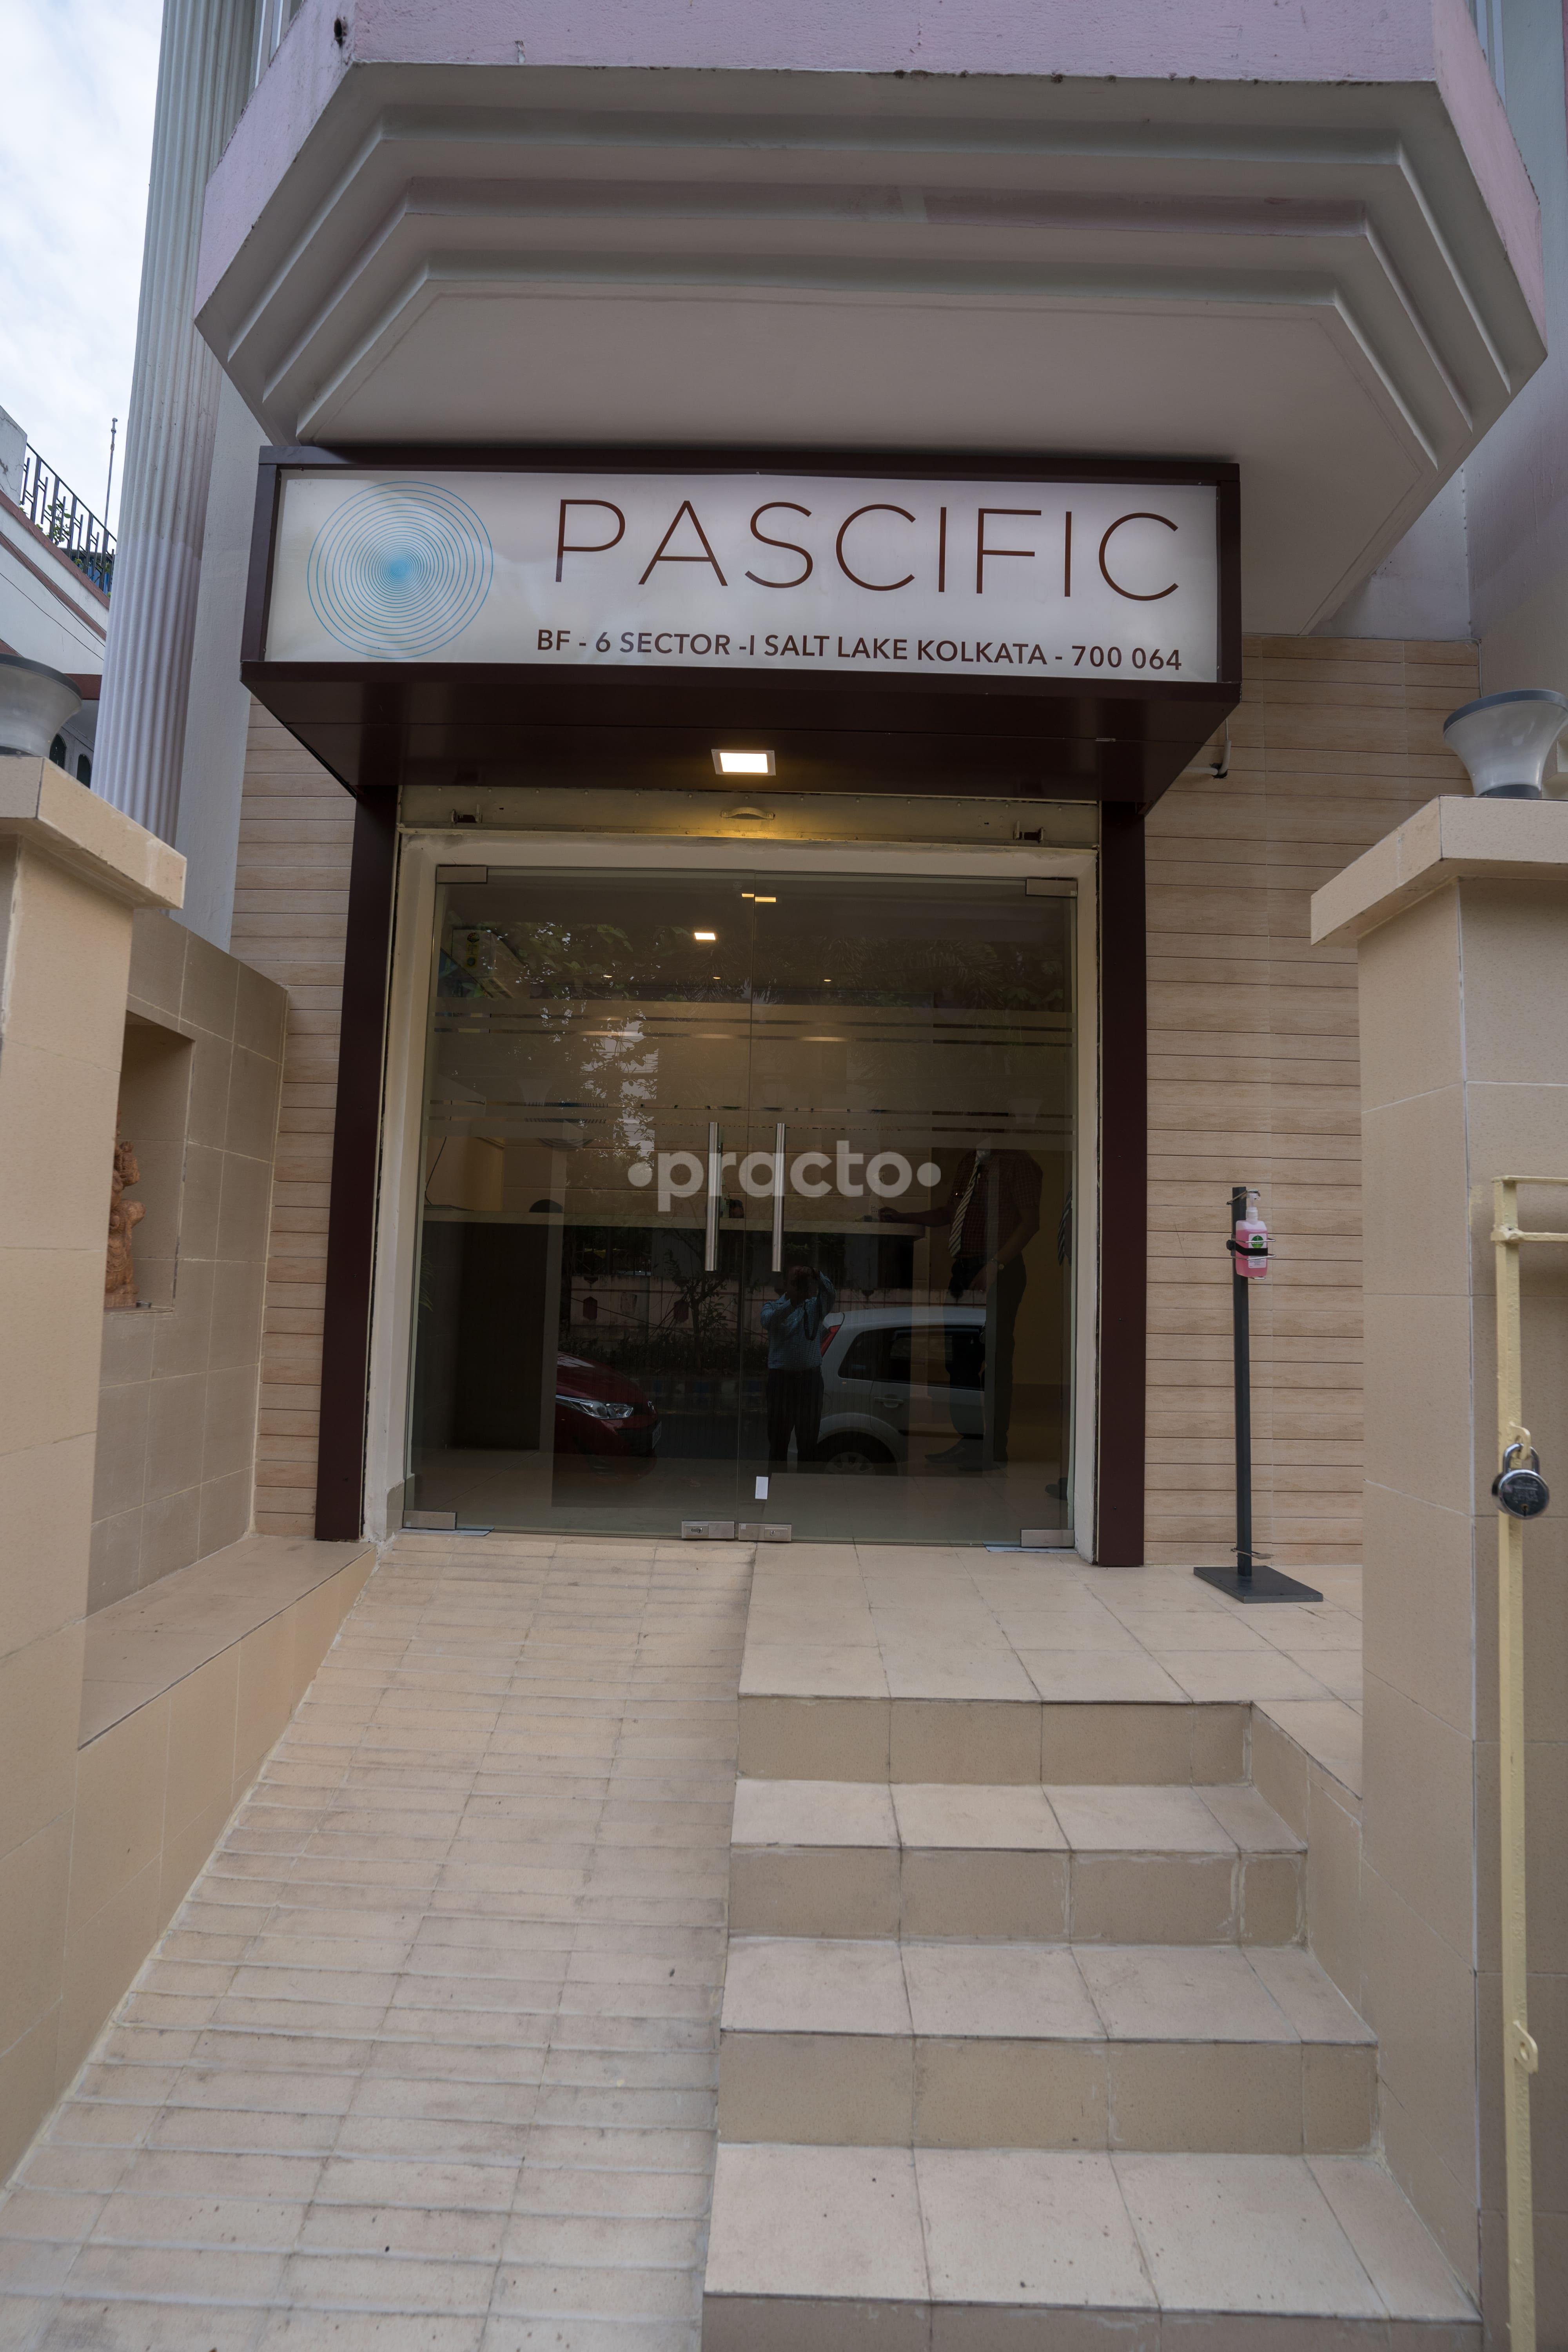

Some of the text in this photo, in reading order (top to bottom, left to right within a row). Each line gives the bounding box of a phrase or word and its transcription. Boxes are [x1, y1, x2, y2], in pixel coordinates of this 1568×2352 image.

[555, 499, 1179, 601] PASCIFIC
[537, 629, 571, 651] BF
[595, 632, 611, 653] 6
[619, 632, 730, 655] SECTOR
[764, 634, 830, 657] SALT
[838, 636, 907, 660] LAKE
[918, 639, 1048, 665] KOLKATA
[1072, 645, 1122, 668] 700
[1132, 647, 1182, 671] 064
